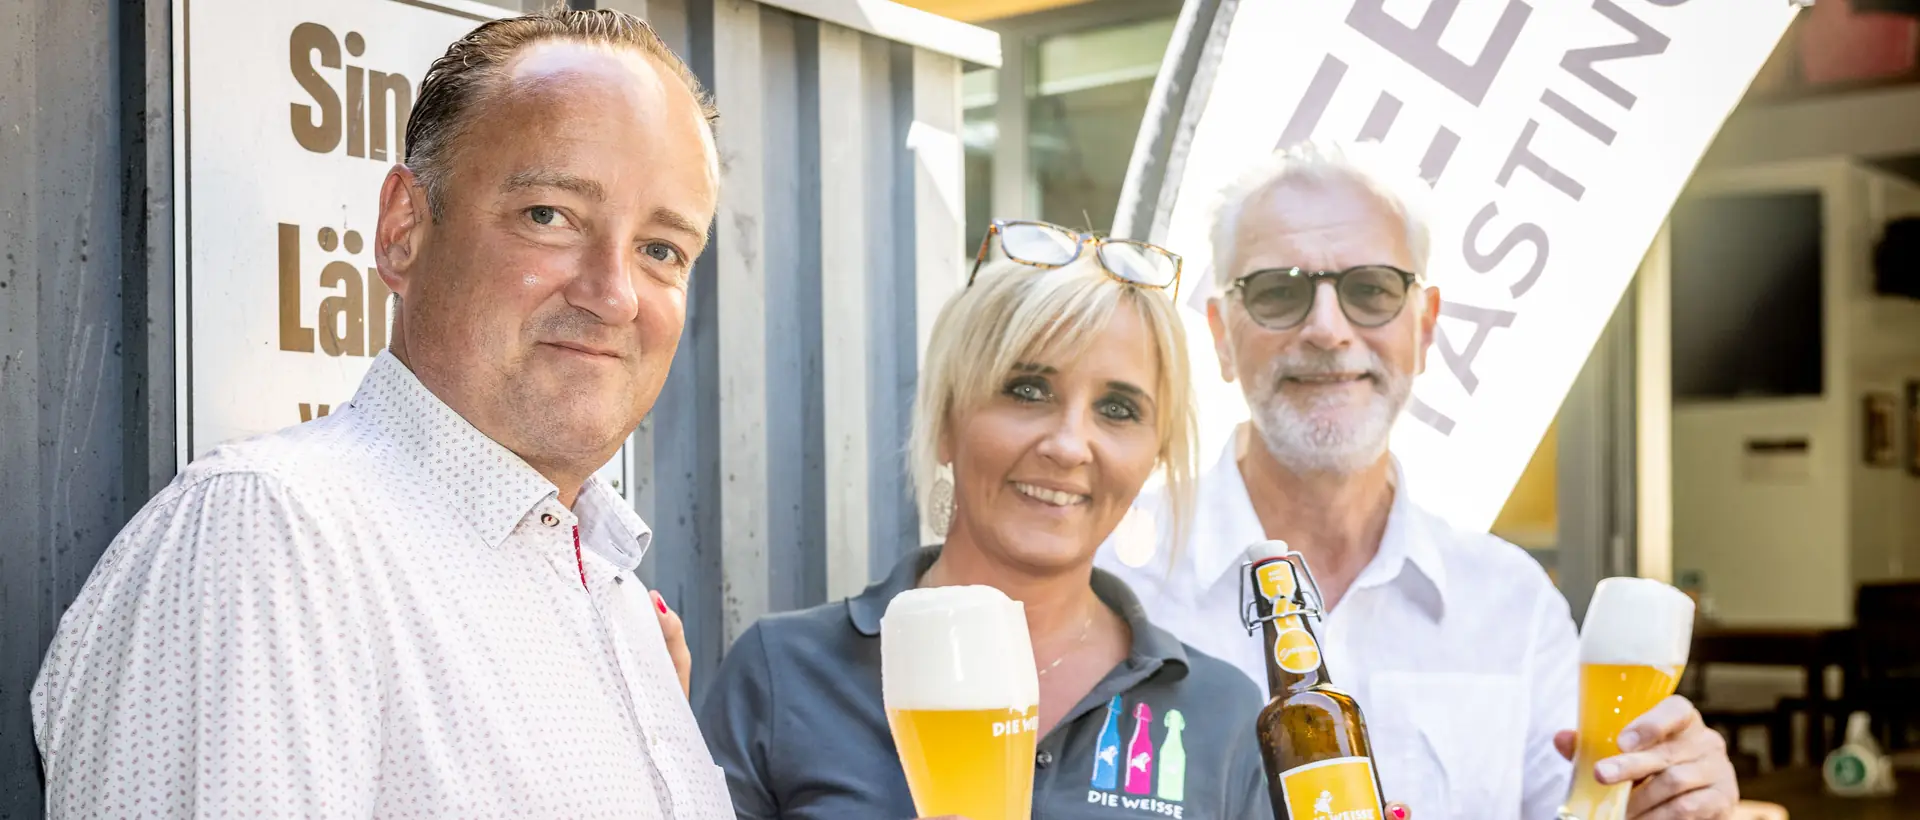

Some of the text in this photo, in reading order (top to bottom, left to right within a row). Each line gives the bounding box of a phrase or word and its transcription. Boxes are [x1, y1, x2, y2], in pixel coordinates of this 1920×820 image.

[290, 22, 422, 163] Sin
[992, 719, 1020, 737] DIE
[1087, 790, 1184, 820] DIE WEISSE
